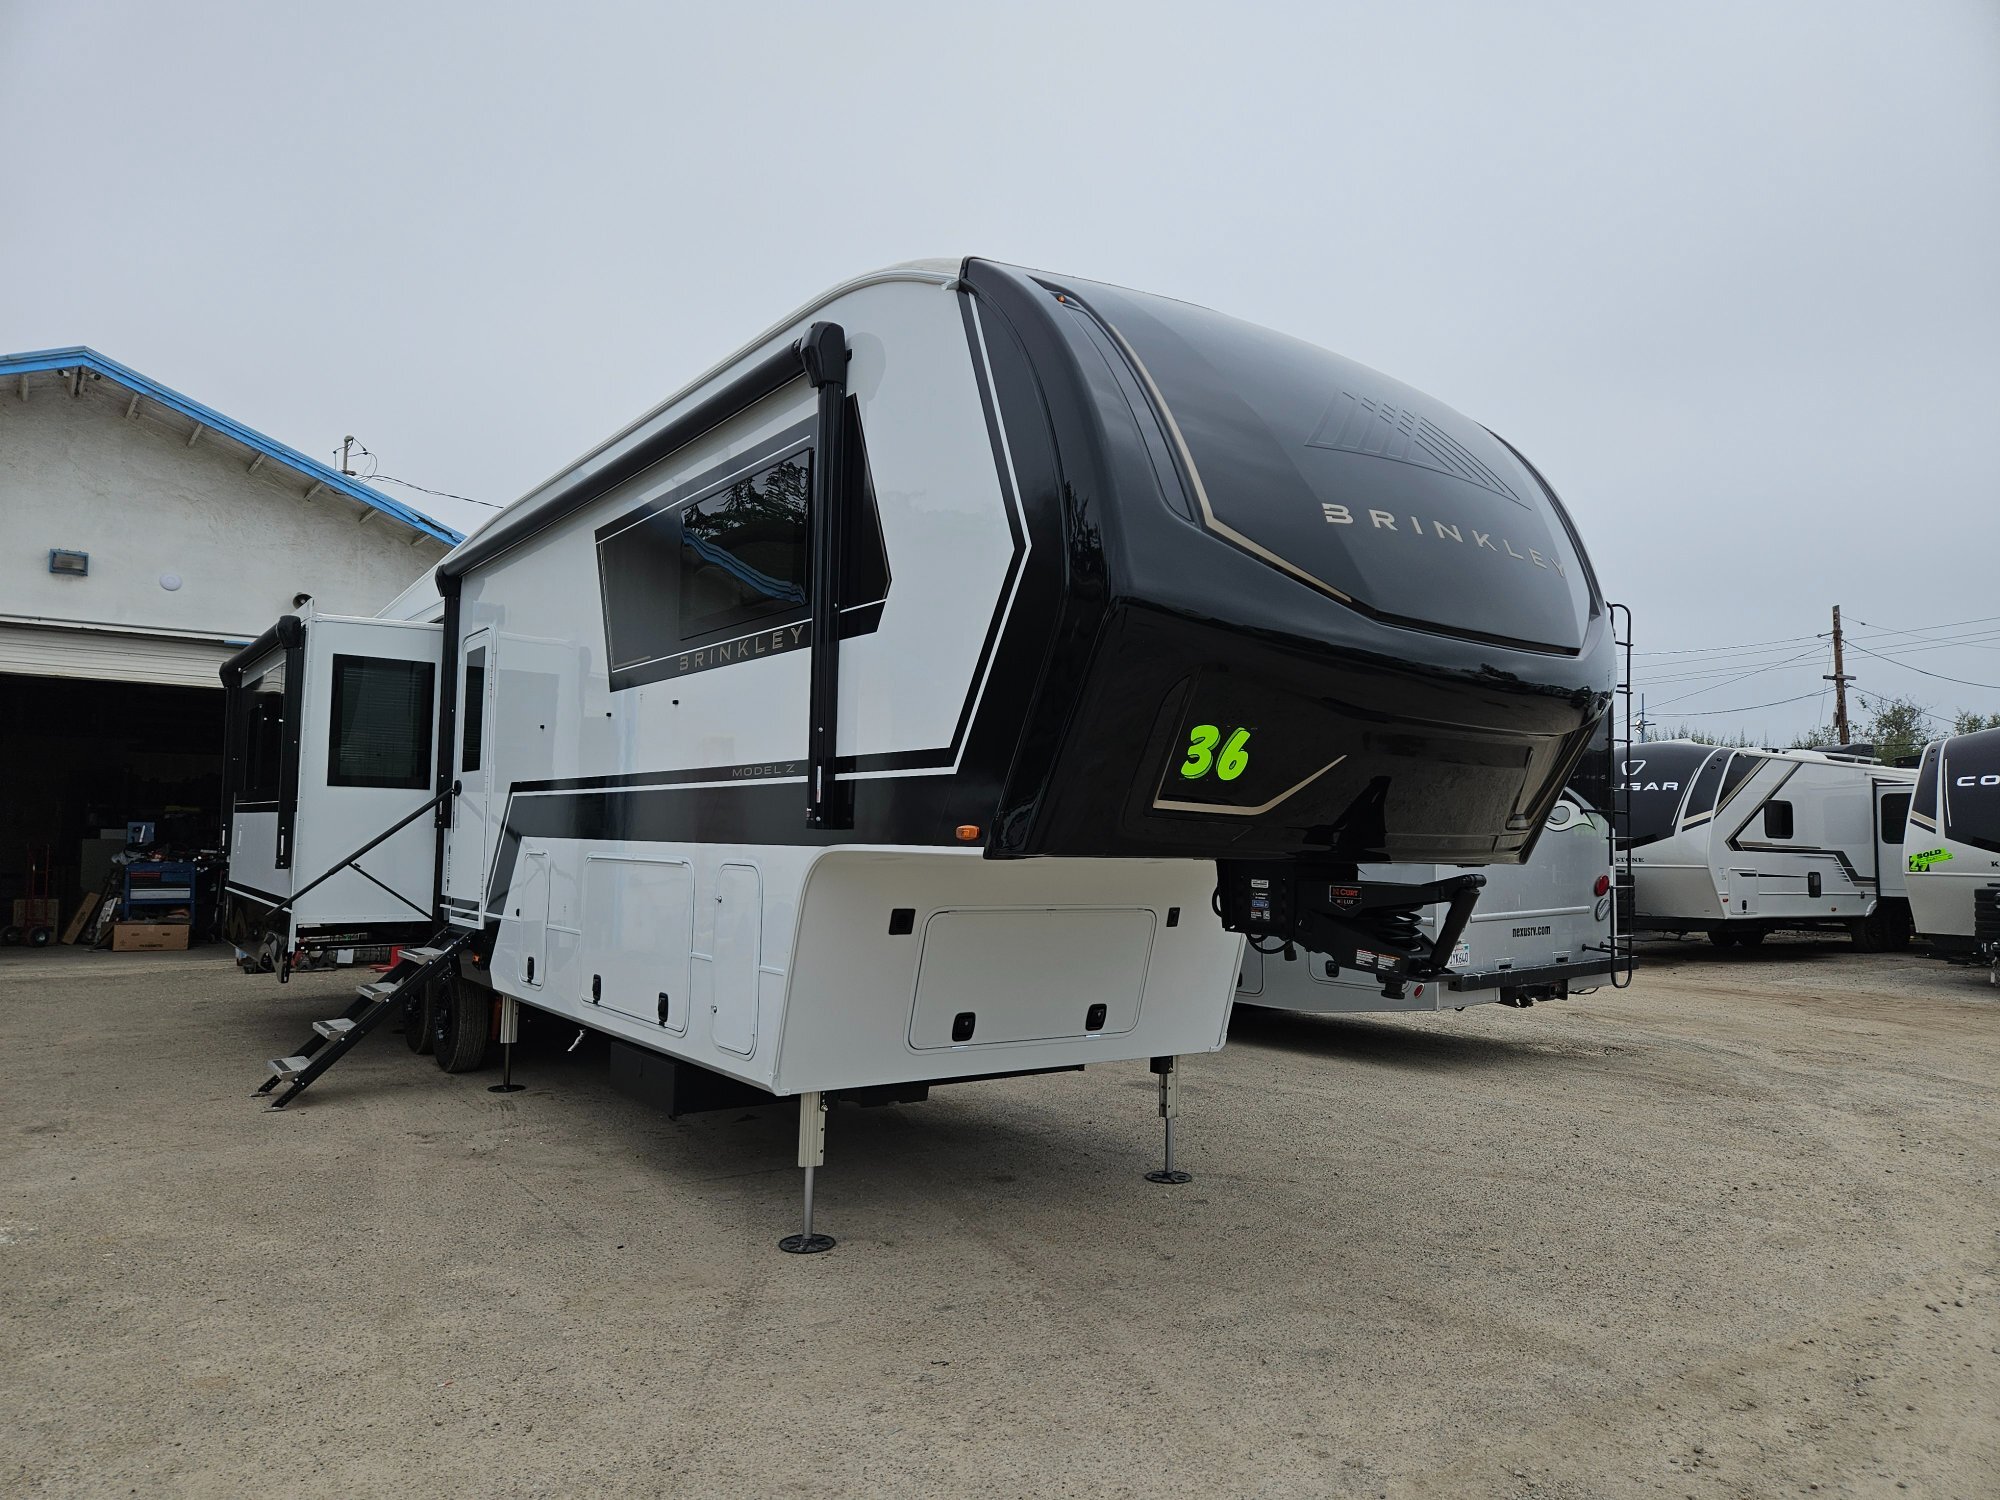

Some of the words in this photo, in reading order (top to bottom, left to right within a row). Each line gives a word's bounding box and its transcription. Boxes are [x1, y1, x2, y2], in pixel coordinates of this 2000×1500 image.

[1322, 503, 1566, 578] BRINKLEY
[679, 626, 804, 671] BRINKLEY
[1180, 724, 1251, 781] 36
[732, 765, 782, 777] MODEL
[785, 763, 796, 773] Z
[1917, 849, 1941, 859] SOLD
[1512, 925, 1551, 938] nexusrv.com
